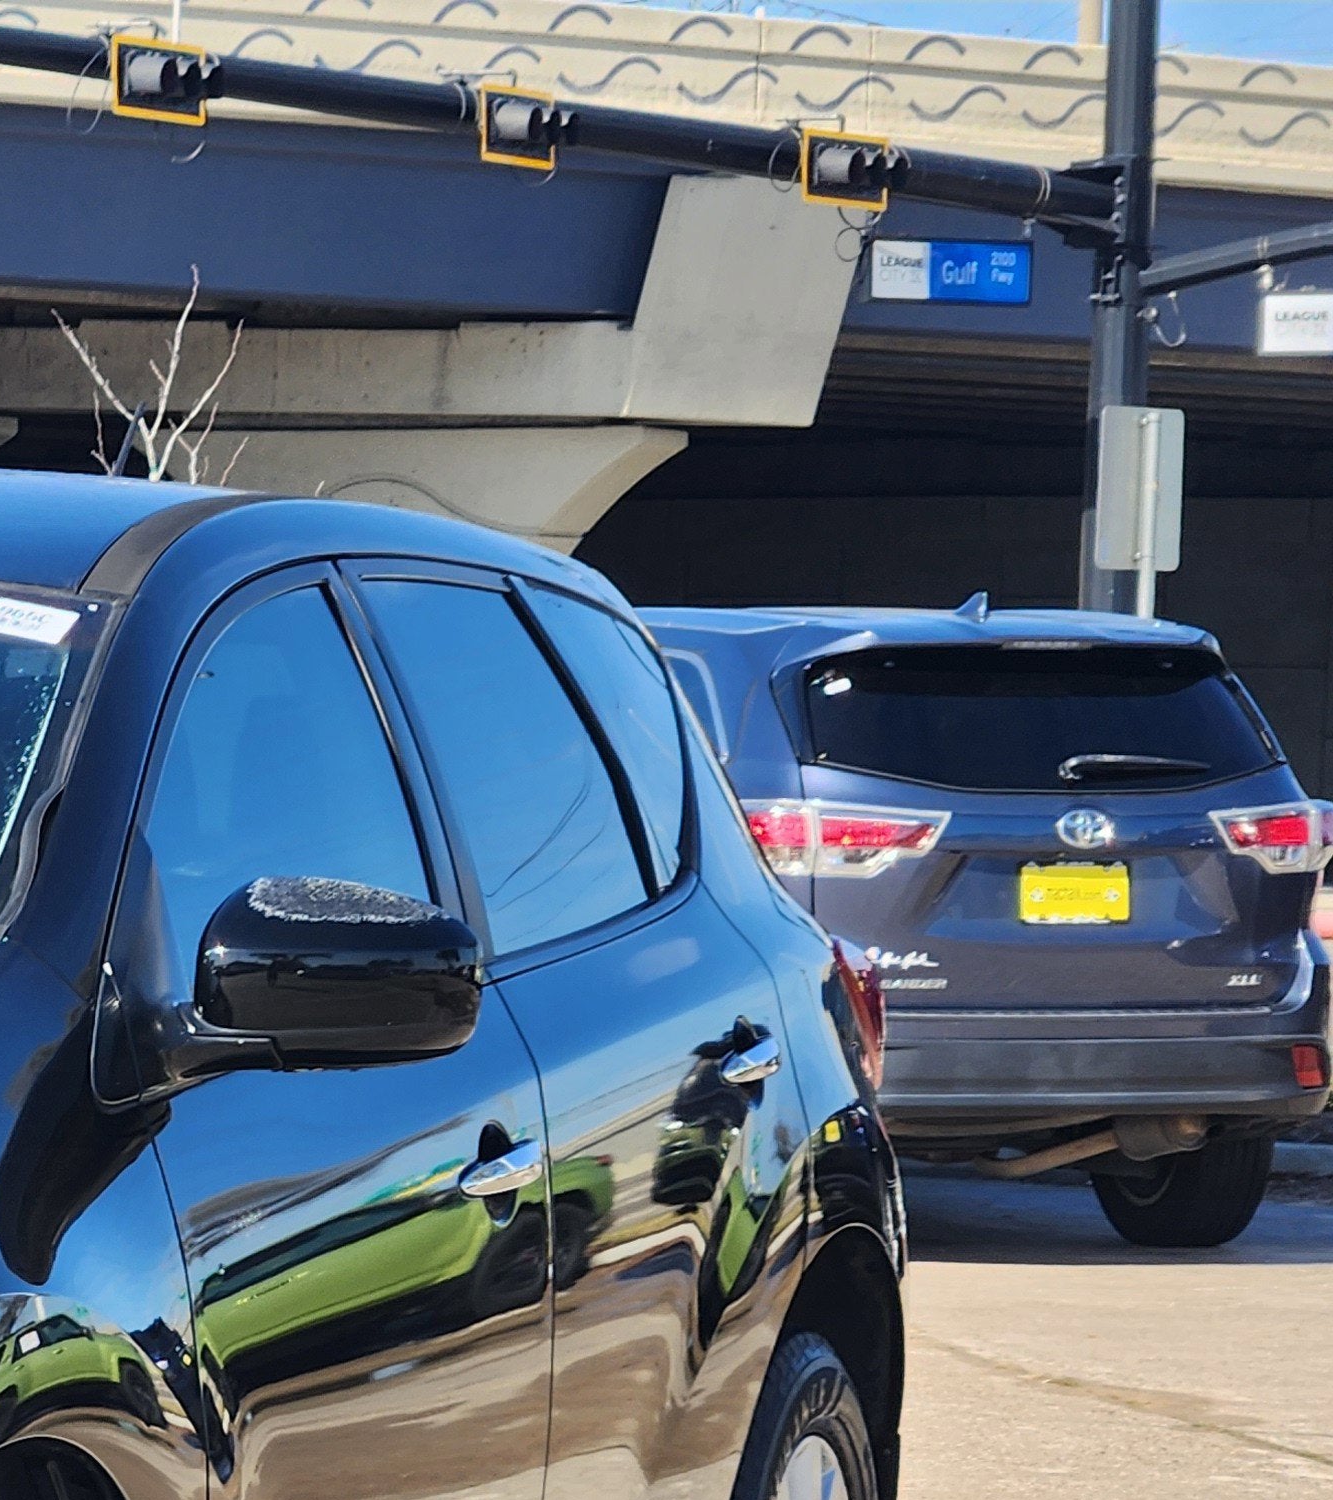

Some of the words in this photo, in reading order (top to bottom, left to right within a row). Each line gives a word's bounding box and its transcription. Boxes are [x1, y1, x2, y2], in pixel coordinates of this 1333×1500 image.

[880, 255, 924, 268] LEAGUE
[941, 259, 979, 285] Gulf
[990, 268, 1015, 286] Fwy
